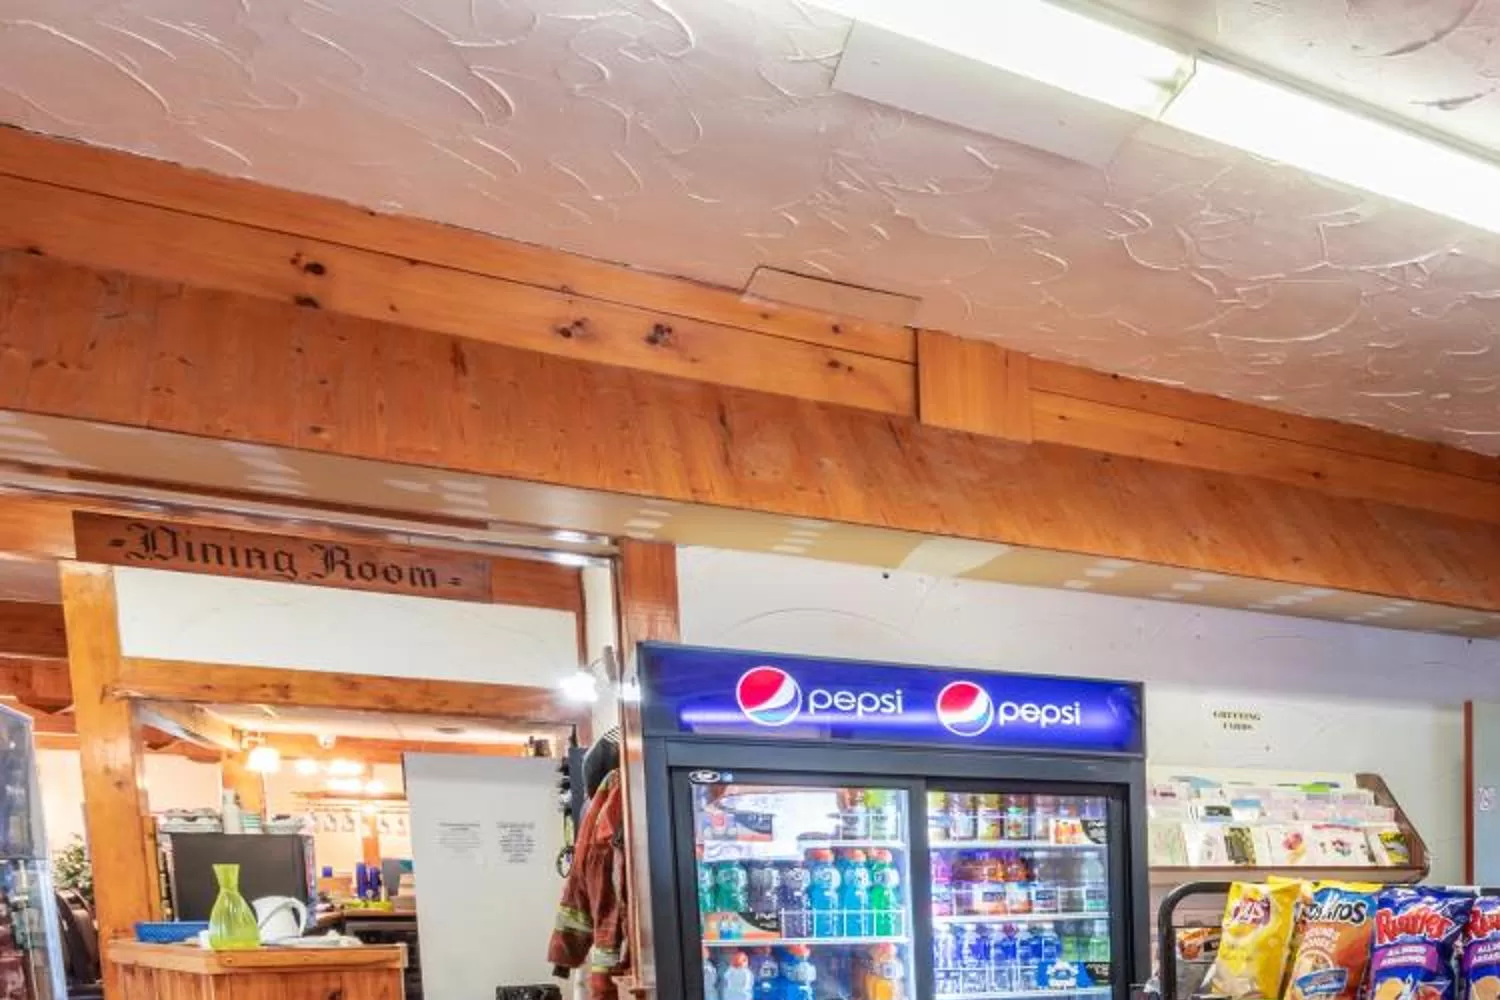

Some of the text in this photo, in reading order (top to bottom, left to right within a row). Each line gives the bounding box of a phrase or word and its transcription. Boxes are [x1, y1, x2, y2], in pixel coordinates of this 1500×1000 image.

[125, 522, 438, 589] Dining Room
[807, 688, 903, 717] pepsi
[998, 700, 1082, 728] pepsi
